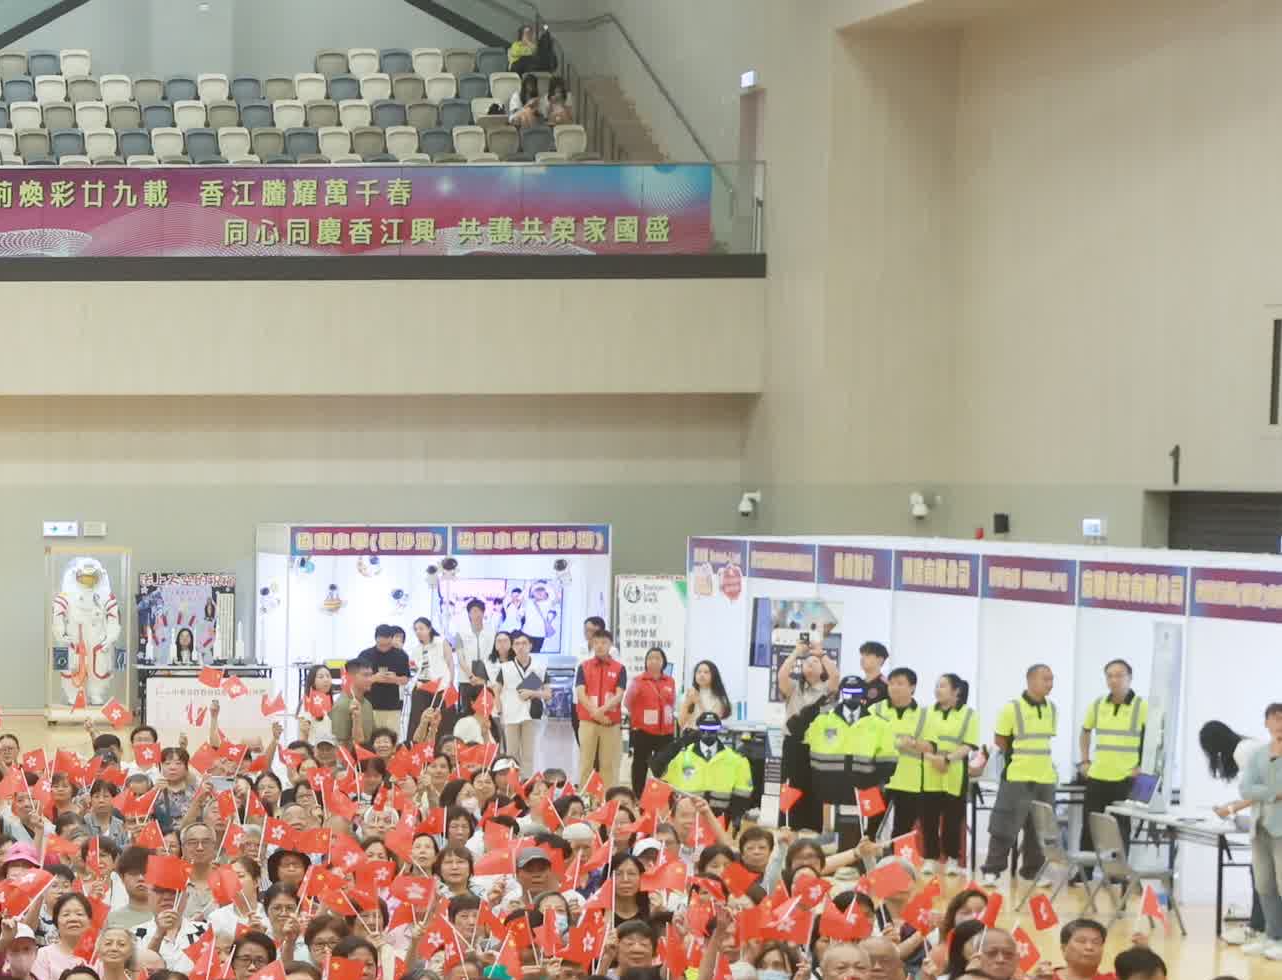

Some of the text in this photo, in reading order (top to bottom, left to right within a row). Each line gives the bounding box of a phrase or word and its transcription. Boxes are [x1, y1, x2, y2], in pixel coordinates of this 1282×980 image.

[224, 215, 671, 246] 同心同慶香江興 共護共榮家國盛
[1168, 444, 1180, 486] 1
